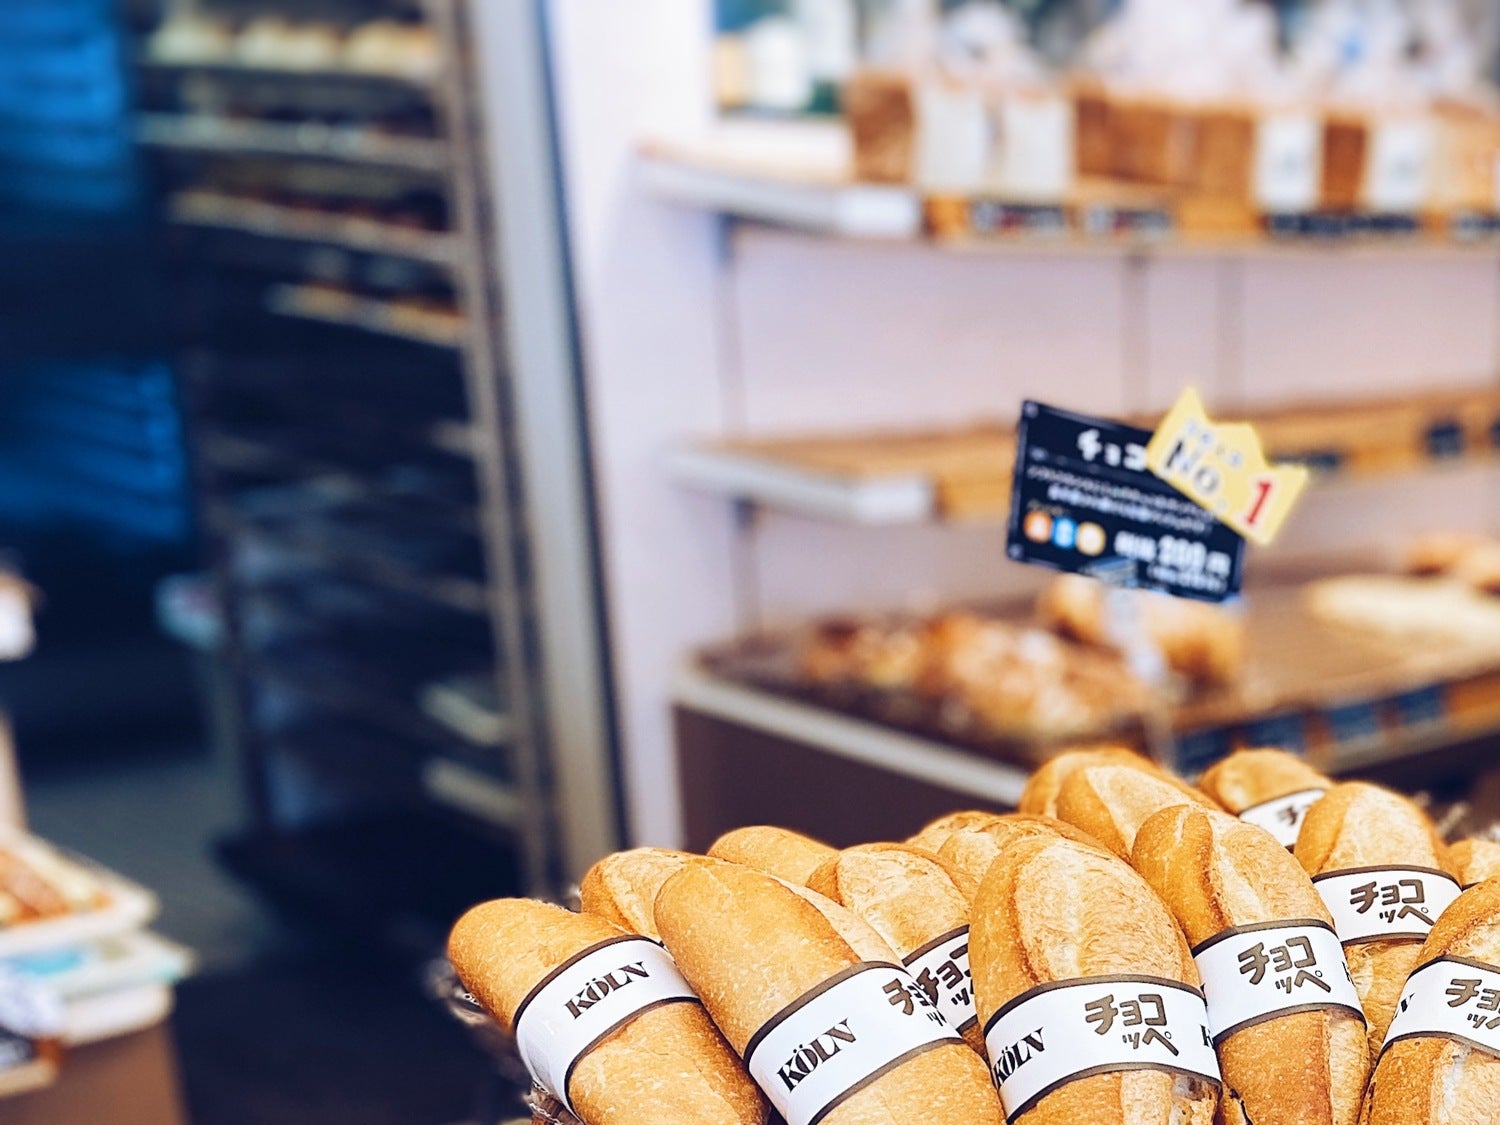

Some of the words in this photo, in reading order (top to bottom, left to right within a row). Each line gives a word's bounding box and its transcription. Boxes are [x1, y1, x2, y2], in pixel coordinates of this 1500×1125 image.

[1246, 481, 1271, 525] 1
[1350, 879, 1424, 914] チョコ
[1380, 905, 1434, 926] ッペ
[1238, 936, 1316, 984] チョコ
[564, 961, 650, 1019] KÖLN
[1276, 970, 1331, 994] ッペ
[1085, 994, 1168, 1035] チョコ
[777, 1018, 856, 1092] KÖLN
[993, 1028, 1045, 1084] KÖLN
[1122, 1028, 1179, 1056] ッペ
